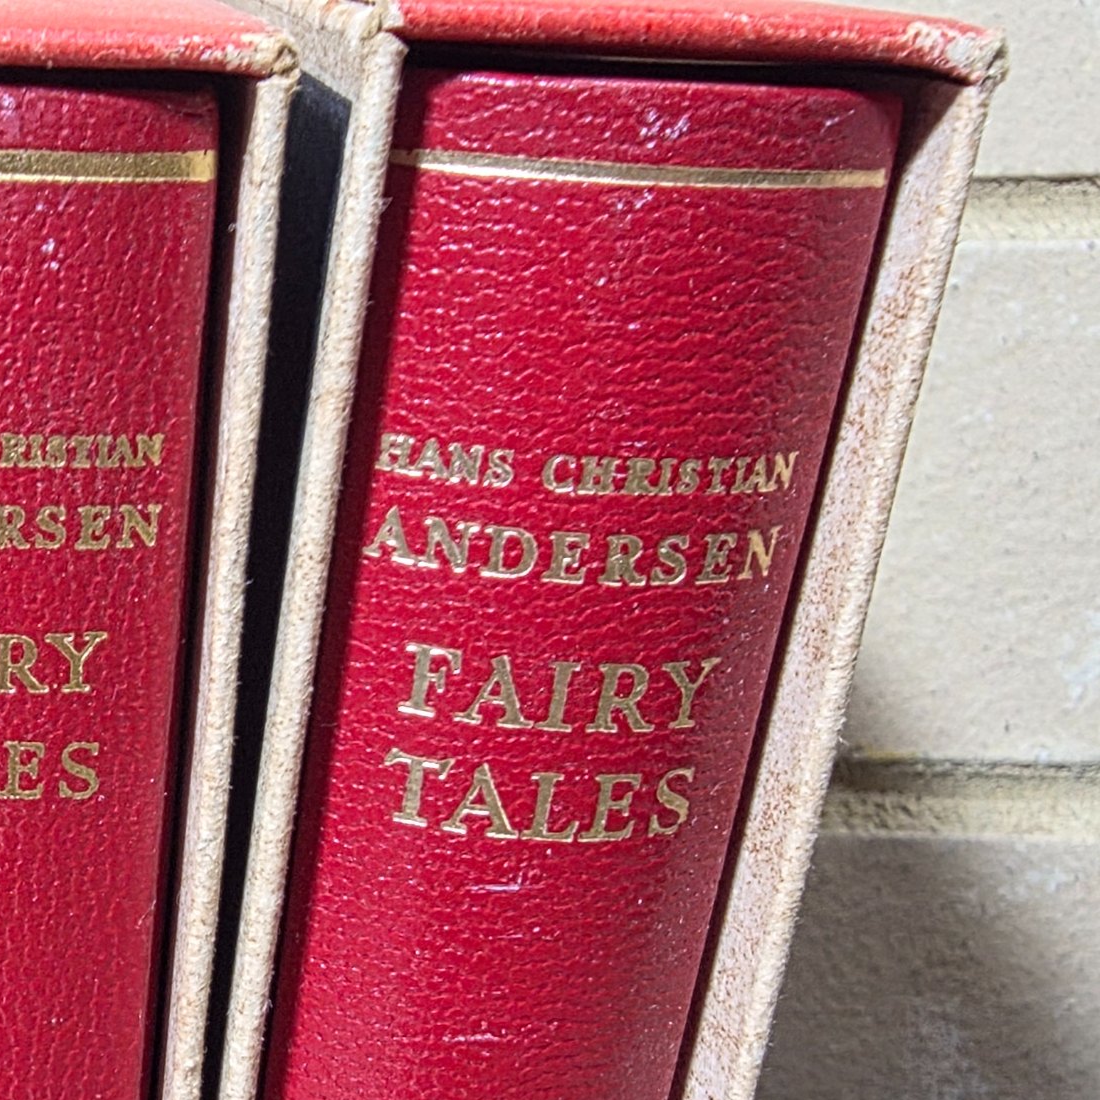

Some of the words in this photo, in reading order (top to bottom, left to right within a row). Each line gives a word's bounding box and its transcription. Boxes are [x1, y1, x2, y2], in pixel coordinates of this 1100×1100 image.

[375, 433, 515, 488] HANS
[541, 450, 799, 497] CHRISTIAN
[362, 505, 784, 587] ANDERSEN
[398, 641, 722, 734] FAIRY
[384, 747, 696, 844] TALES
